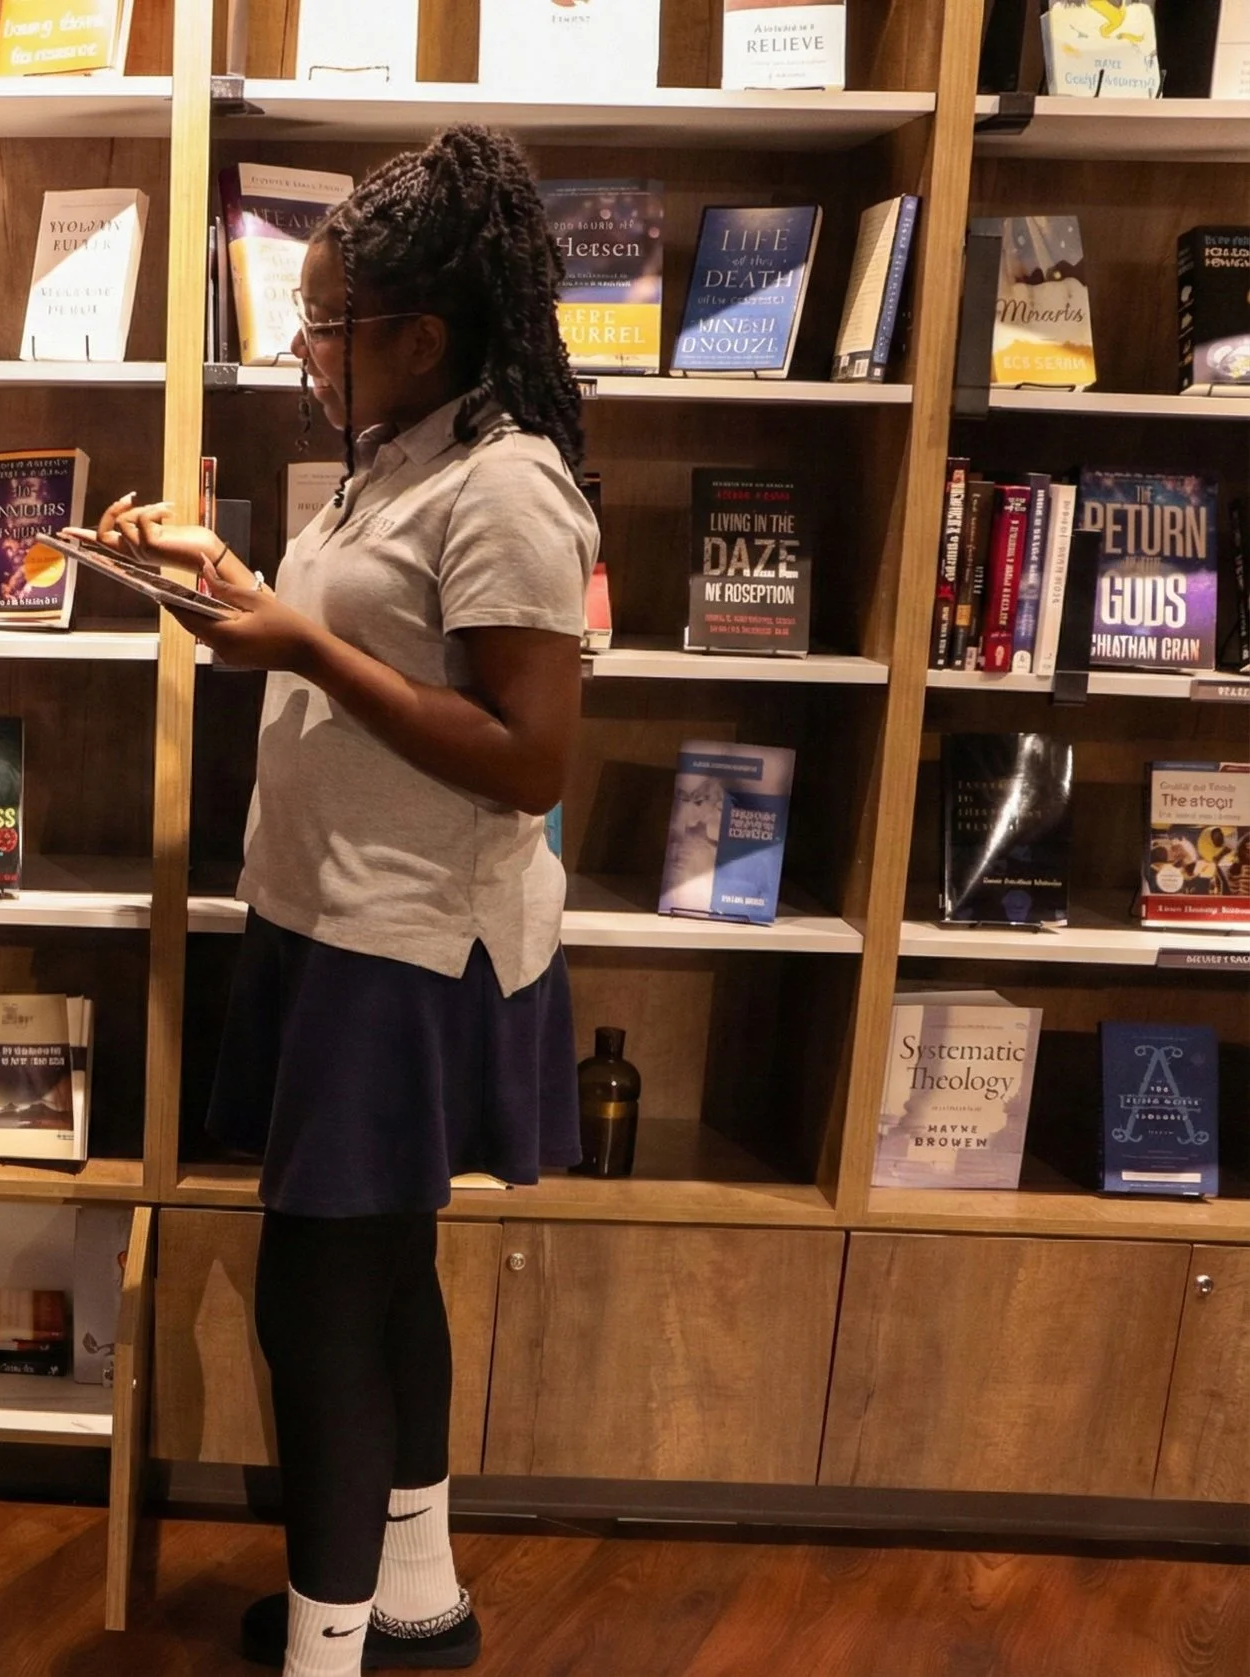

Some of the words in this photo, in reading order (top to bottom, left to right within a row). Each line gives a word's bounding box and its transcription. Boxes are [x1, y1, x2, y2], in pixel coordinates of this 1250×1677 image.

[746, 36, 825, 53] RELIEVE
[721, 229, 791, 251] LIFE
[704, 270, 794, 289] DEATH
[710, 512, 751, 532] LIVING
[771, 514, 795, 534] THE
[702, 536, 800, 579] DAZE
[1101, 570, 1187, 629] GODS
[899, 1035, 1026, 1066] Systematic
[906, 1066, 1015, 1102] Theology
